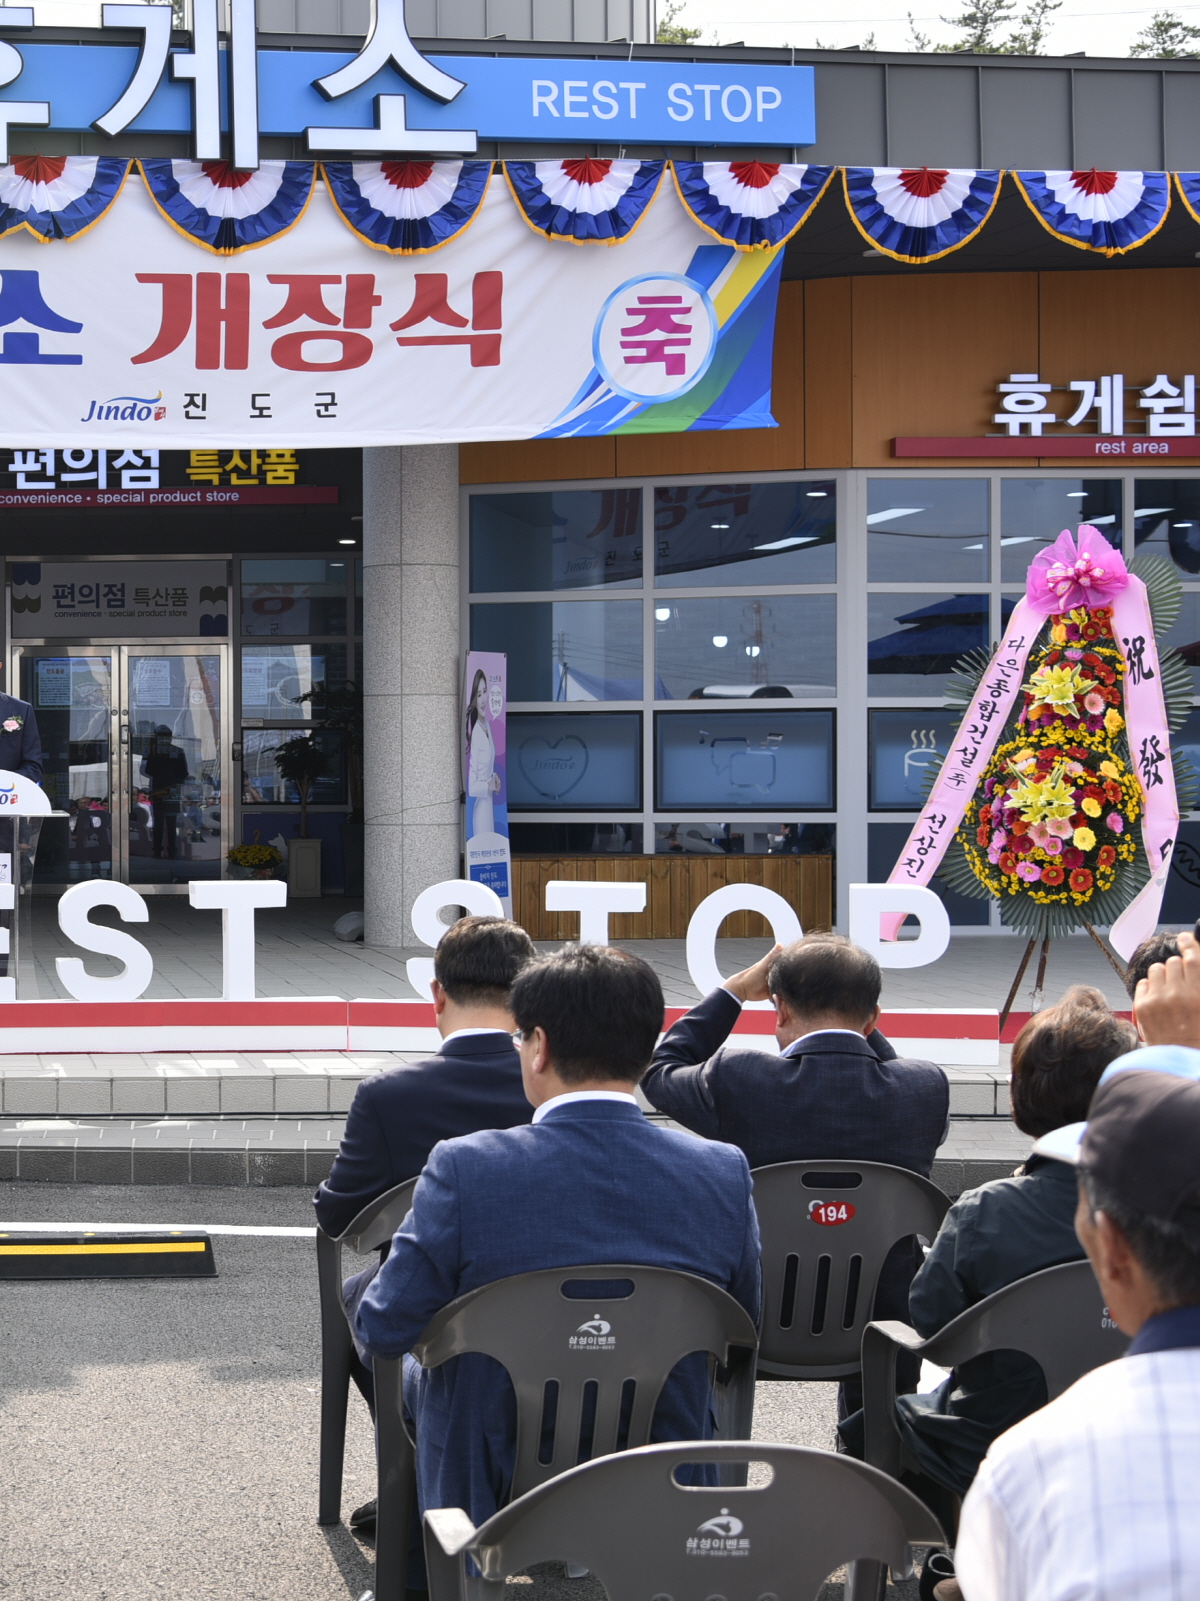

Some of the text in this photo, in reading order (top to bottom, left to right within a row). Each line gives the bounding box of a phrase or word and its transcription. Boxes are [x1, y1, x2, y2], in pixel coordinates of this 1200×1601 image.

[531, 79, 783, 123] REST STOP
[130, 270, 502, 373] 개장식
[620, 295, 693, 376] 축
[81, 395, 155, 424] Jindo
[992, 373, 1196, 437] 휴게쉼
[1095, 441, 1169, 454] rest area
[8, 447, 299, 490] 편의점 특산품
[96, 490, 144, 505] special
[150, 489, 202, 505] product
[206, 489, 240, 502] store
[52, 582, 190, 609] 편의점 특산품
[108, 609, 136, 618] special
[137, 609, 167, 618] product
[819, 1204, 847, 1223] 194
